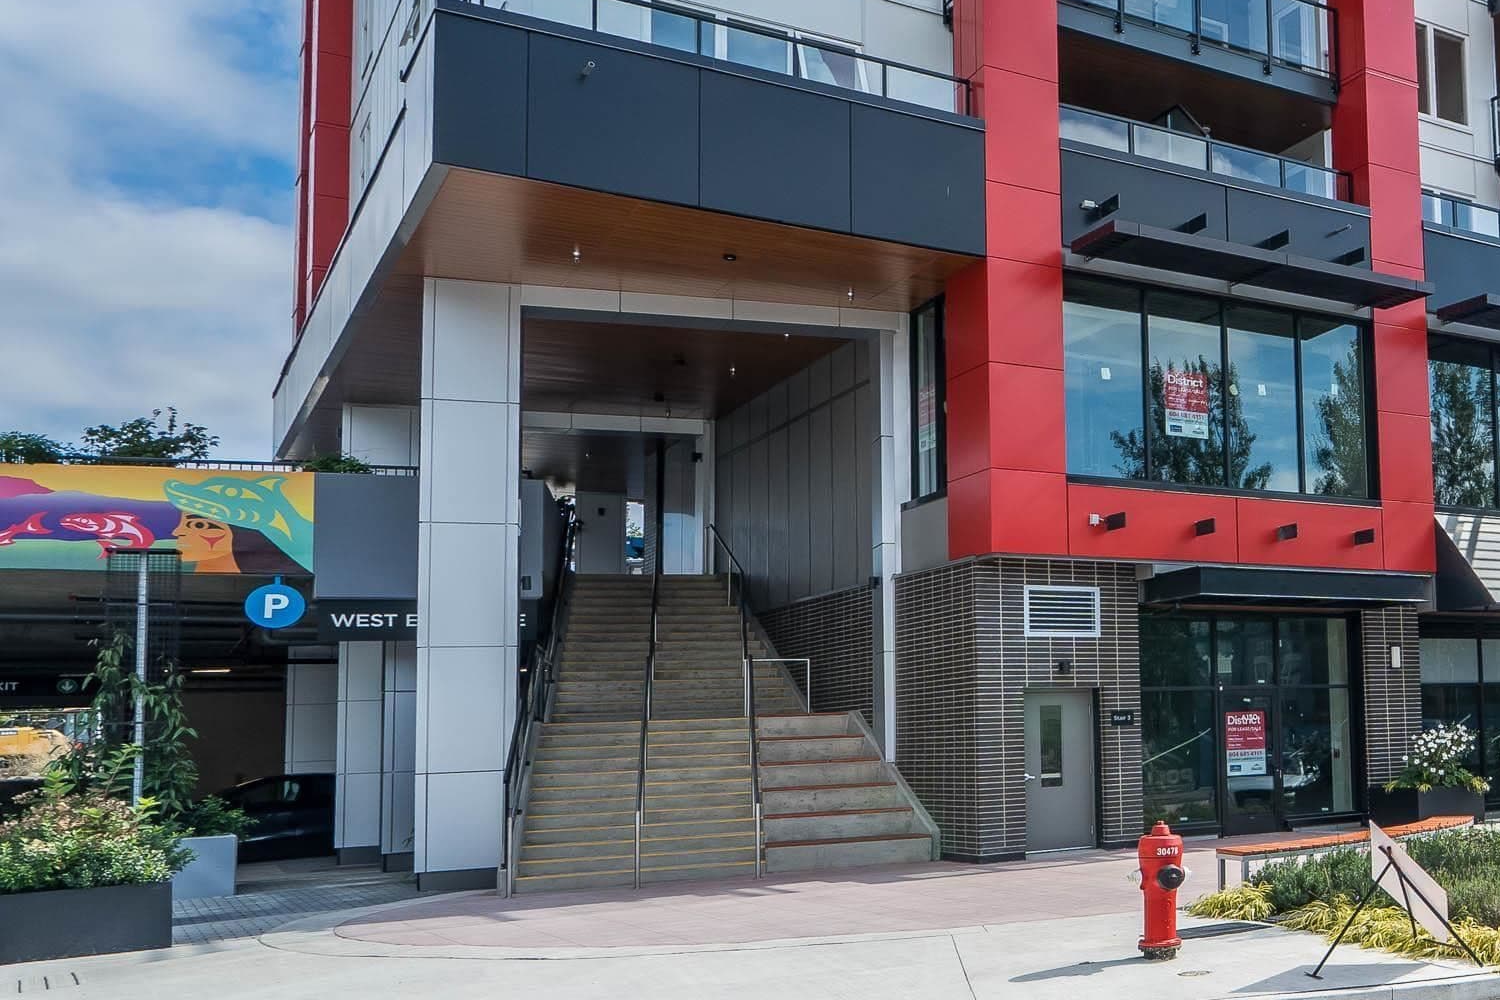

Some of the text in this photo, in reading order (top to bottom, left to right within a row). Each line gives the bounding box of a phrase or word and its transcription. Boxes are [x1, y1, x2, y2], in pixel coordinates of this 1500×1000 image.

[1167, 374, 1203, 387] District
[263, 593, 290, 619] P
[330, 613, 398, 628] WEST
[1227, 715, 1261, 725] District
